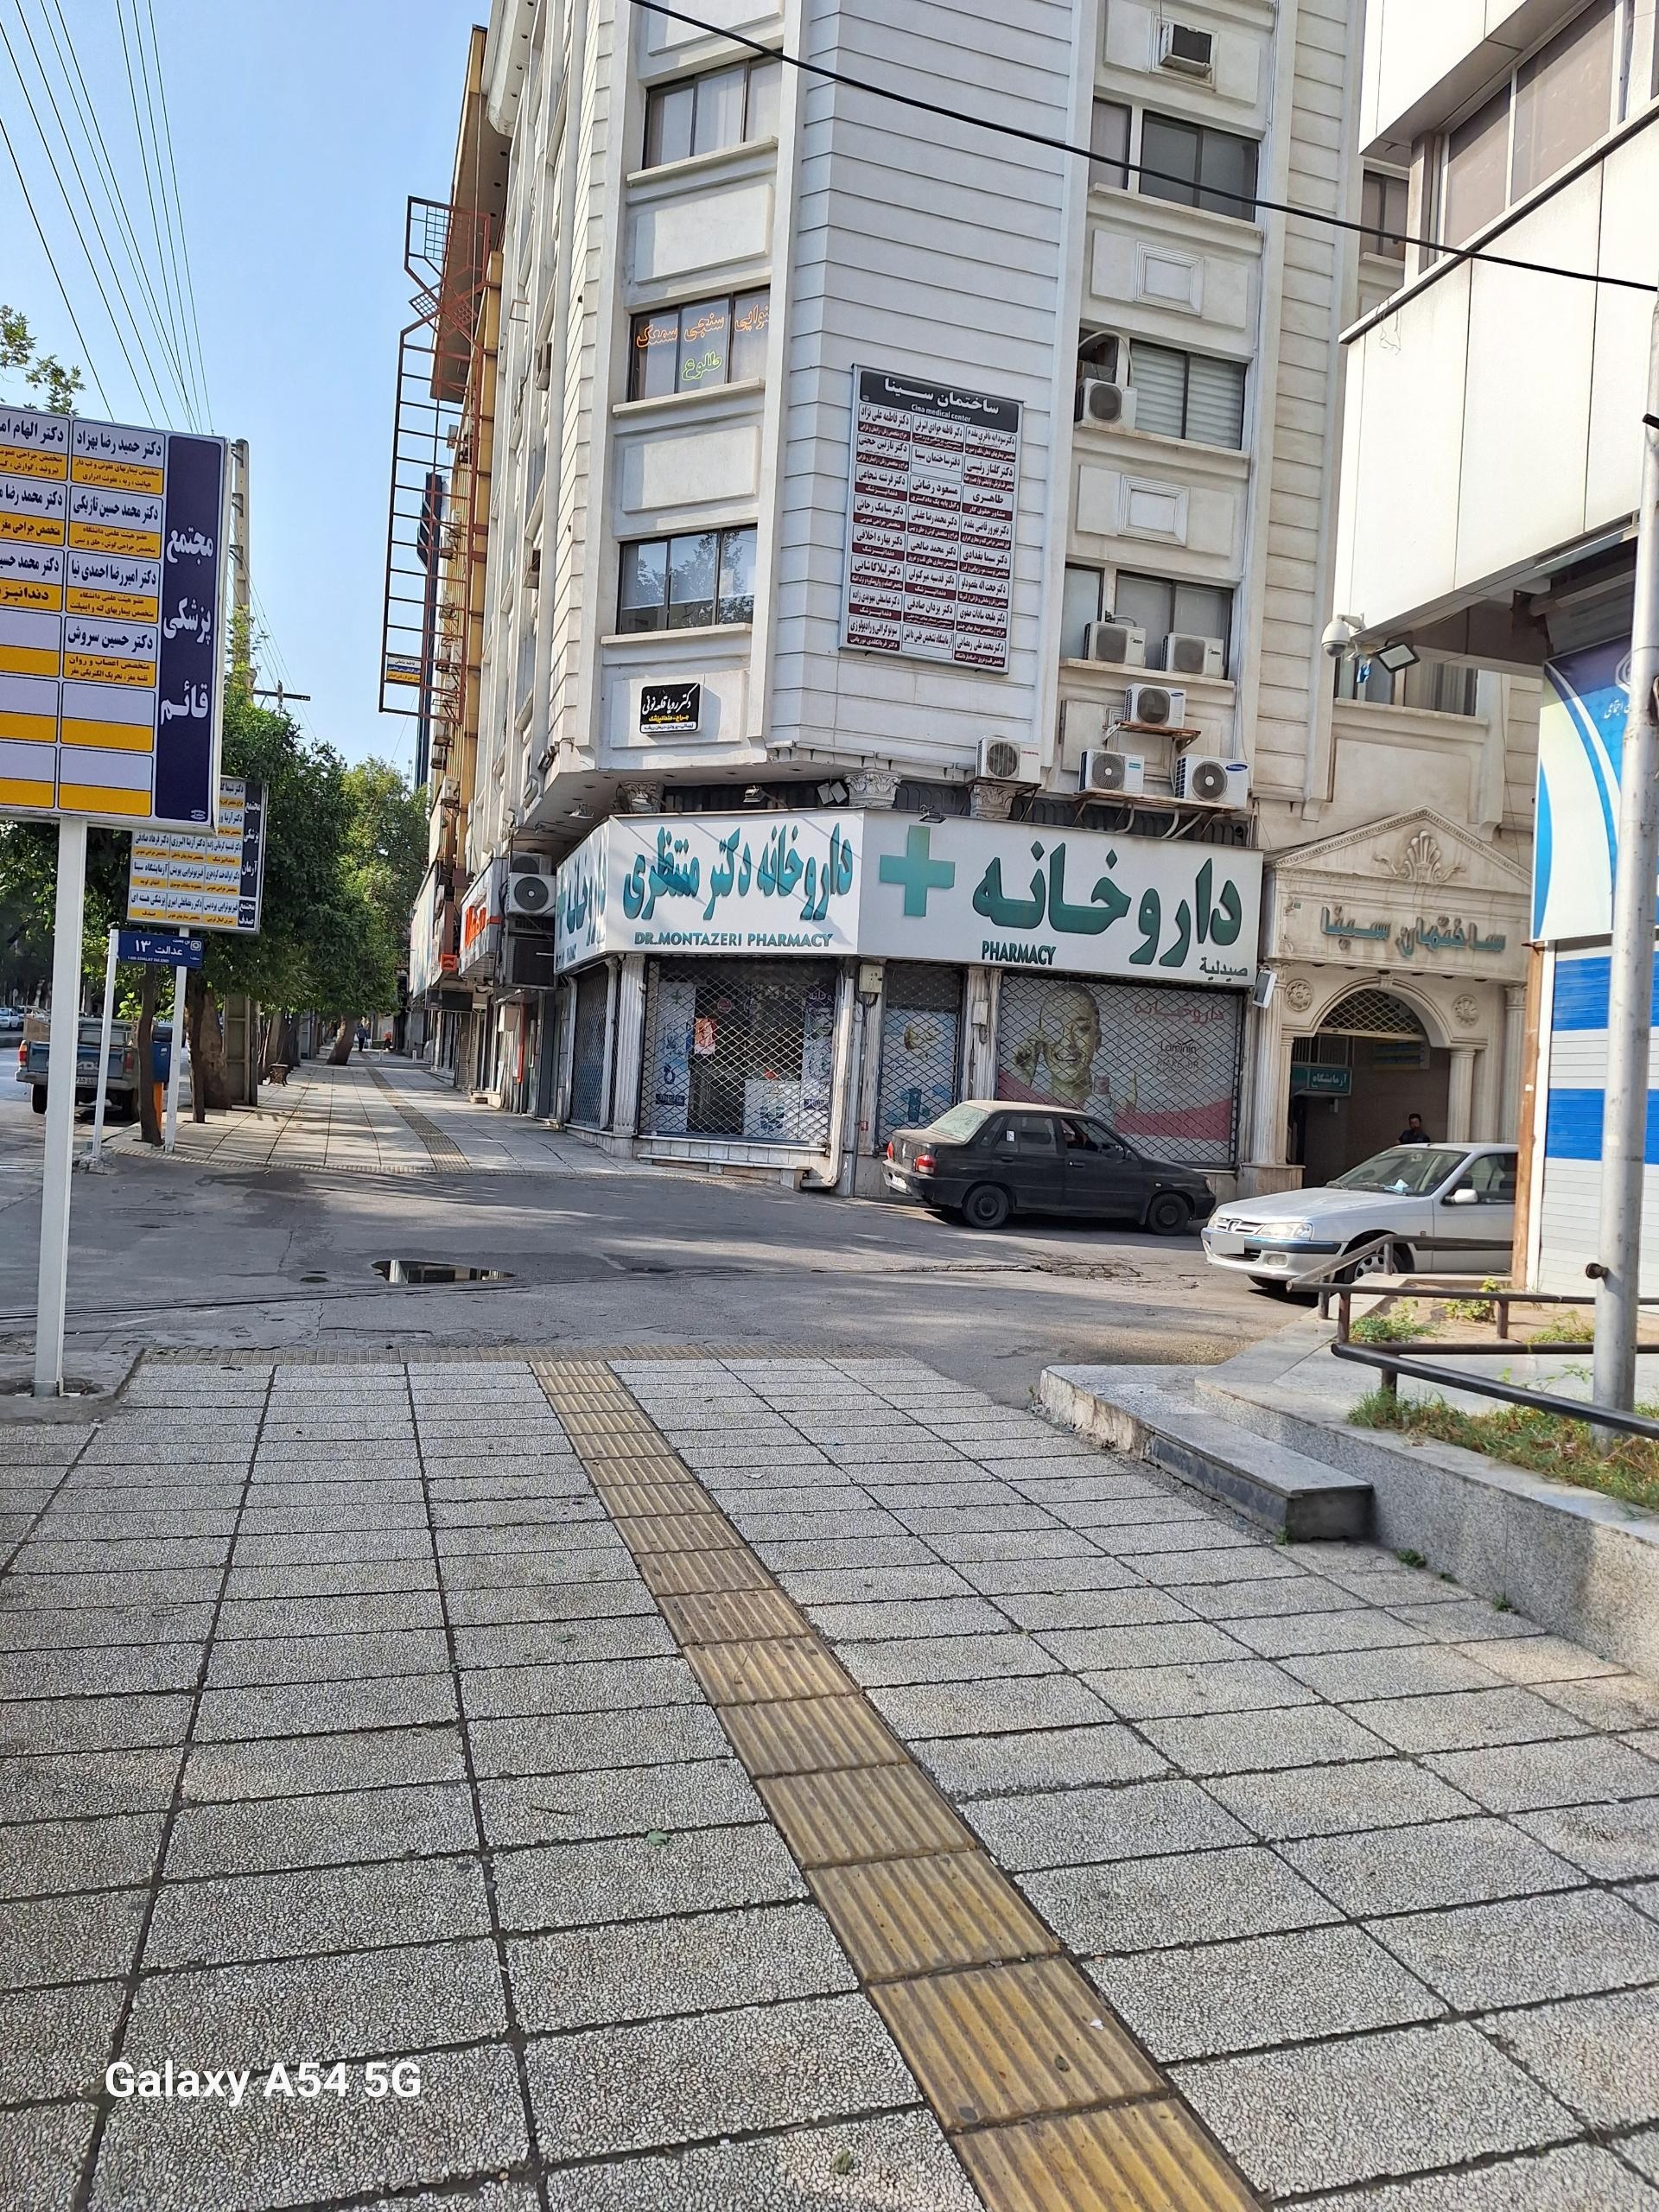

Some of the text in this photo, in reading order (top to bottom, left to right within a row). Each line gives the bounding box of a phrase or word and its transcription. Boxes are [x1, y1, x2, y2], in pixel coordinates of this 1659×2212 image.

[682, 349, 722, 381] طلوع
[885, 378, 998, 413] ساختمان سینا
[872, 409, 881, 421] علی
[883, 411, 897, 423] فاطمه
[911, 404, 925, 412] Cina
[925, 409, 950, 417] medical
[898, 414, 908, 427] دکتر
[13, 420, 37, 439] الهام
[40, 426, 63, 443] دکتر
[77, 430, 161, 459] دکتر حمید رضا بهزاد
[858, 435, 876, 449] حجتی
[894, 442, 906, 453] دکتر
[16, 451, 62, 465] متخصص جراحی
[915, 448, 925, 460] سینا
[966, 461, 984, 474] رئیسی
[1000, 467, 1012, 478] دکتر
[858, 467, 905, 486] دکتر فرشته شجاعی
[5, 484, 62, 509] دکتر محمد رضا
[937, 485, 957, 495] مسعود
[972, 488, 1004, 508] طاهری
[99, 505, 119, 517] حسین
[122, 505, 140, 517] محمد
[142, 505, 157, 523] دکتر
[874, 502, 891, 514] سیامک
[892, 505, 903, 516] دکتر
[968, 504, 976, 514] کار
[1, 519, 60, 536] متخصص جراحی مغز
[856, 529, 875, 541] اخلاقی
[166, 526, 214, 565] مجتمع
[891, 536, 902, 547] دکتر
[910, 541, 928, 550] صالحی
[945, 546, 956, 556] دکتر
[963, 550, 1007, 565] دکتر سیما بغدادی
[0, 556, 58, 575] دکتر محمد حسی
[82, 564, 107, 580] احمدی
[855, 560, 876, 571] کاشانی
[887, 565, 900, 576] دکتر
[110, 564, 137, 585] امیررضا
[139, 569, 156, 588] دکتر
[0, 587, 48, 601] دندانپز
[105, 606, 130, 616] بیماریهای
[907, 598, 952, 615] دکتر یزدان صادقی
[163, 596, 213, 645] پزشکی
[67, 626, 152, 652] دکتر حسین سروش
[69, 656, 86, 665] روان
[120, 661, 149, 672] متخصص
[160, 680, 209, 726] قائم
[676, 683, 699, 713] دکتر
[232, 814, 242, 824] دکتر
[244, 829, 259, 844] پزشکی
[241, 861, 258, 876] آرمان
[623, 822, 853, 920] داروخانه دکتر منتظری
[972, 841, 1242, 967] داروخانه
[1320, 904, 1507, 958] ساختمان سینا
[634, 931, 834, 947] DR.MONTAZERI PHARMACY
[136, 939, 183, 956] عدالت ۱۳
[982, 940, 1057, 965] PHARMACY
[1198, 957, 1249, 982] صیدلیة
